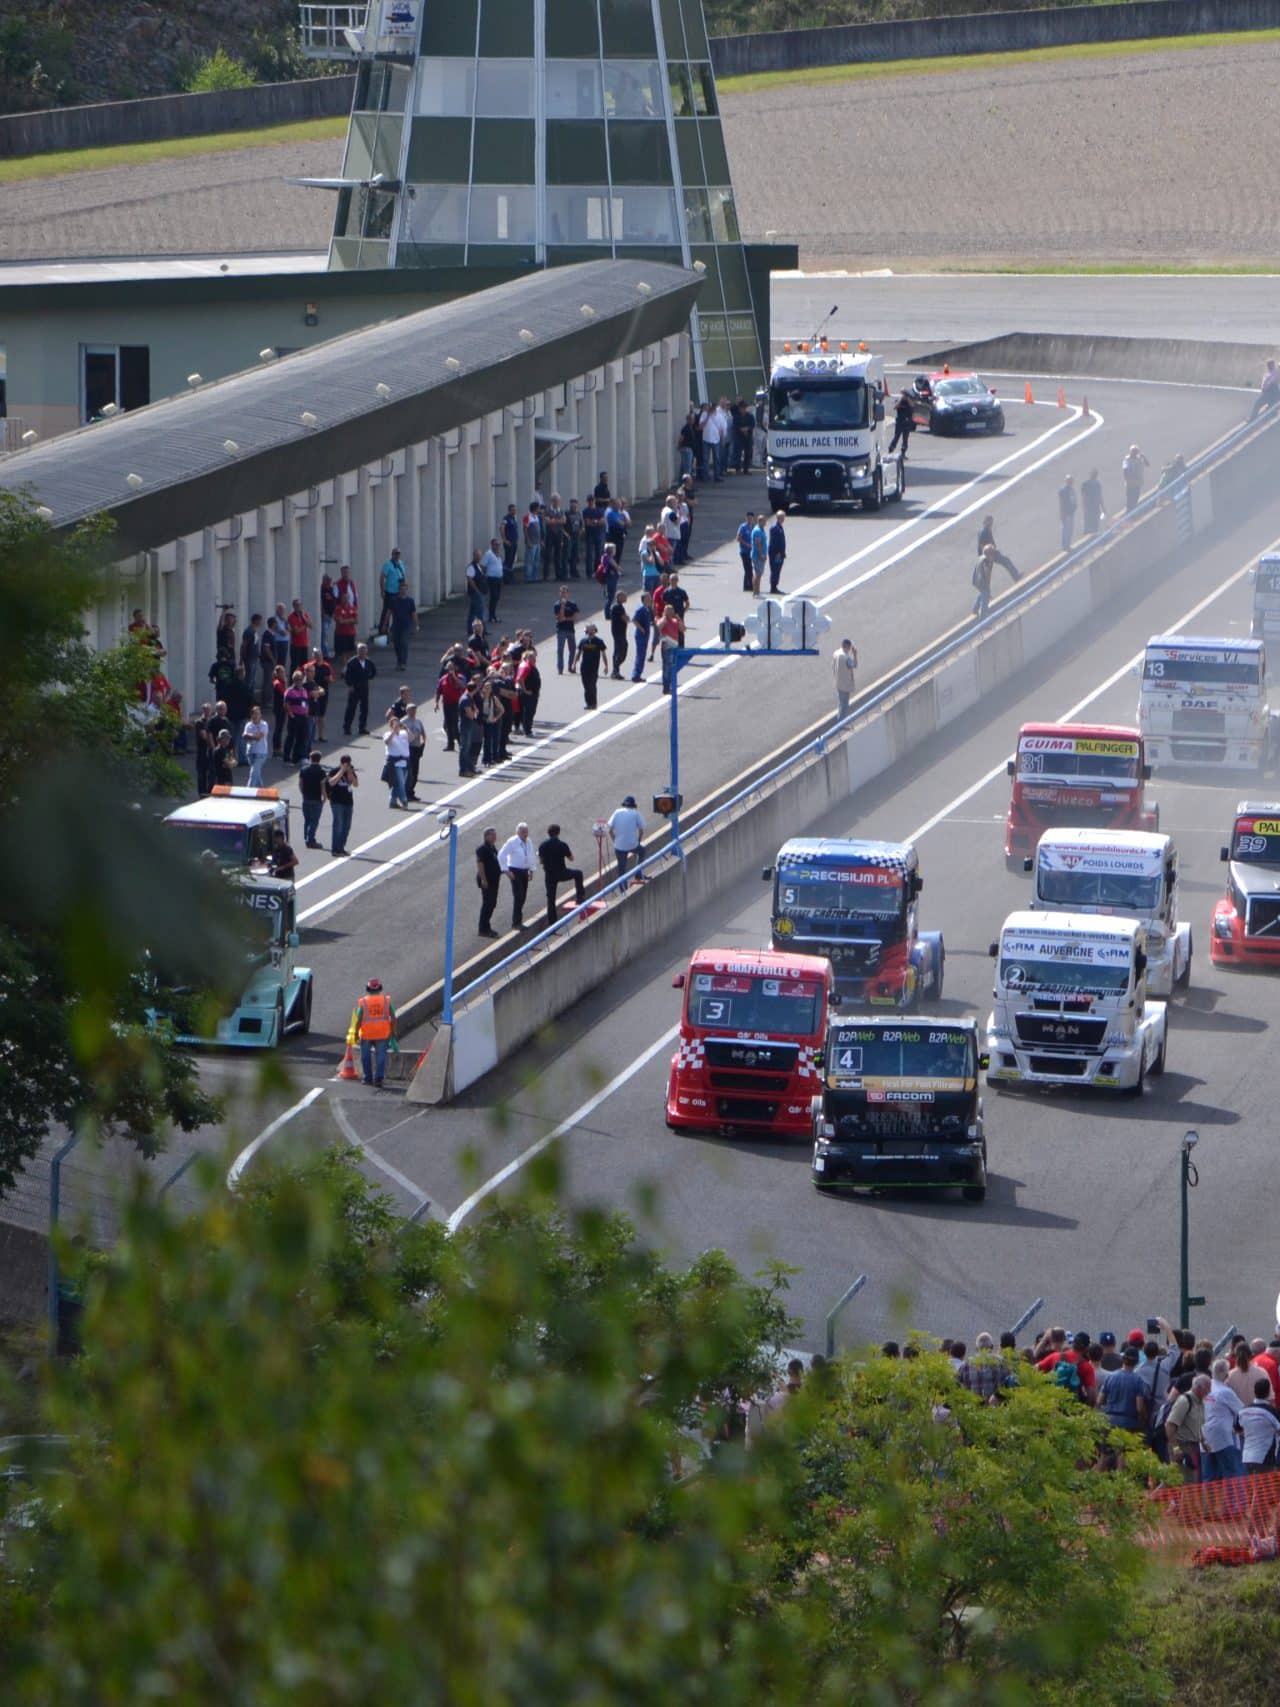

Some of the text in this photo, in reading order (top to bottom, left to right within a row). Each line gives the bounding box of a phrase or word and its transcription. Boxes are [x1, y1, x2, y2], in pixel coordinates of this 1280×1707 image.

[775, 436, 860, 449] OFFICIAL PACE TRUCK
[1147, 662, 1165, 678] 13
[1181, 699, 1218, 708] DAF
[1024, 739, 1074, 751] GUIMA
[1075, 740, 1134, 754] PALFINGER
[1022, 753, 1045, 774] 31
[1236, 835, 1267, 854] 39
[1082, 858, 1108, 868] POIDS
[1109, 859, 1145, 871] LOURDS
[799, 869, 875, 882] PRECISIUM
[783, 888, 795, 904] 5
[1039, 943, 1095, 958] AUVERGNE
[1008, 967, 1022, 983] 2
[705, 1001, 725, 1020] 3
[1041, 1023, 1080, 1034] MAN
[837, 1031, 876, 1043] B2PWeb
[882, 1031, 921, 1043] B2PWeb
[928, 1032, 967, 1045] B2PWeb
[731, 1050, 772, 1061] MAN
[839, 1049, 854, 1069] 4
